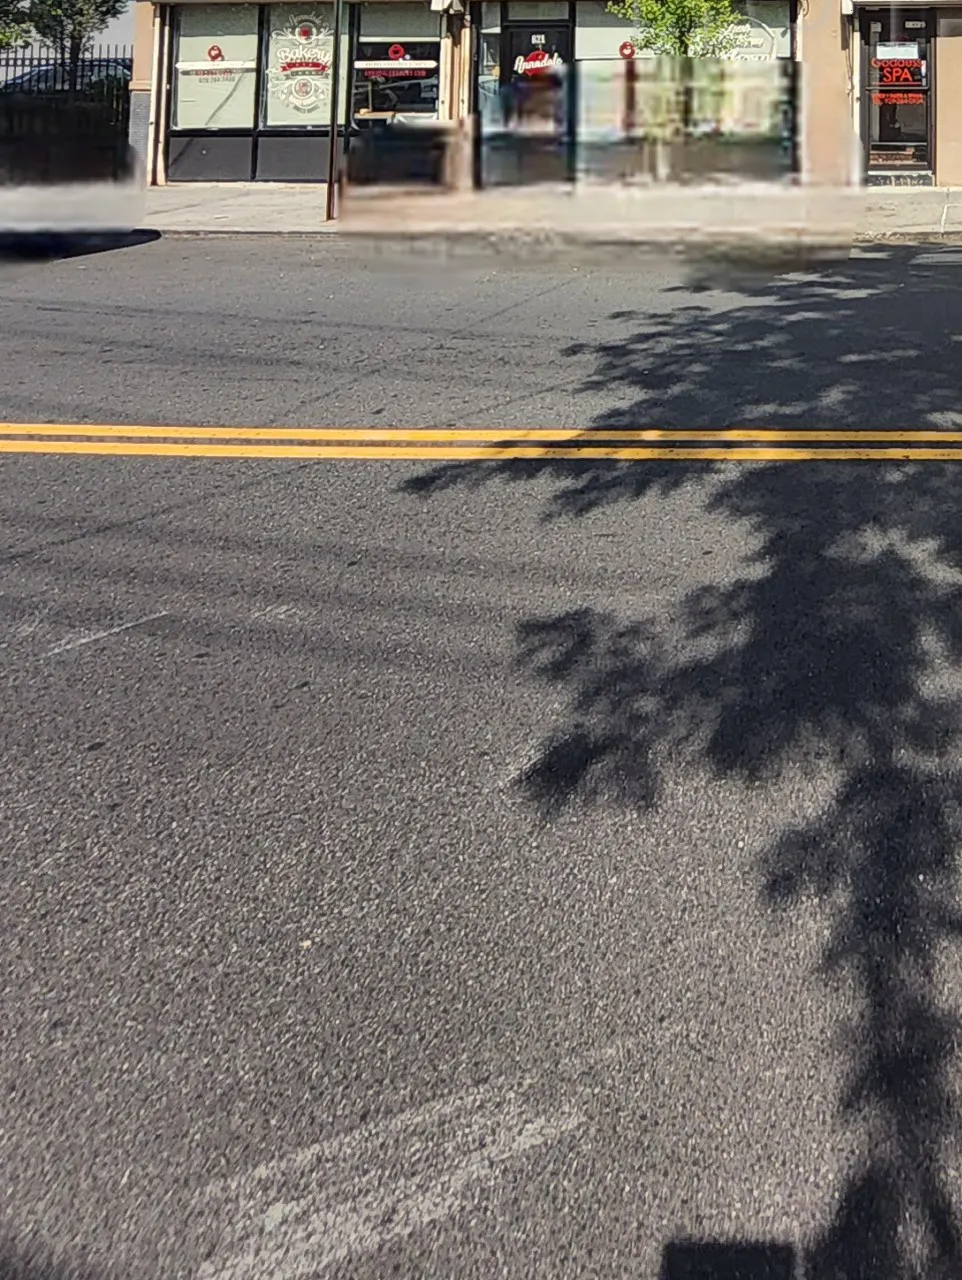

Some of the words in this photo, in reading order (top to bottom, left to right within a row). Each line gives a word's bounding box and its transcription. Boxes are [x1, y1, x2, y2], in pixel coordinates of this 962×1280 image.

[277, 46, 332, 67] Bakery
[514, 52, 564, 74] Annadale
[883, 69, 913, 82] SPA
